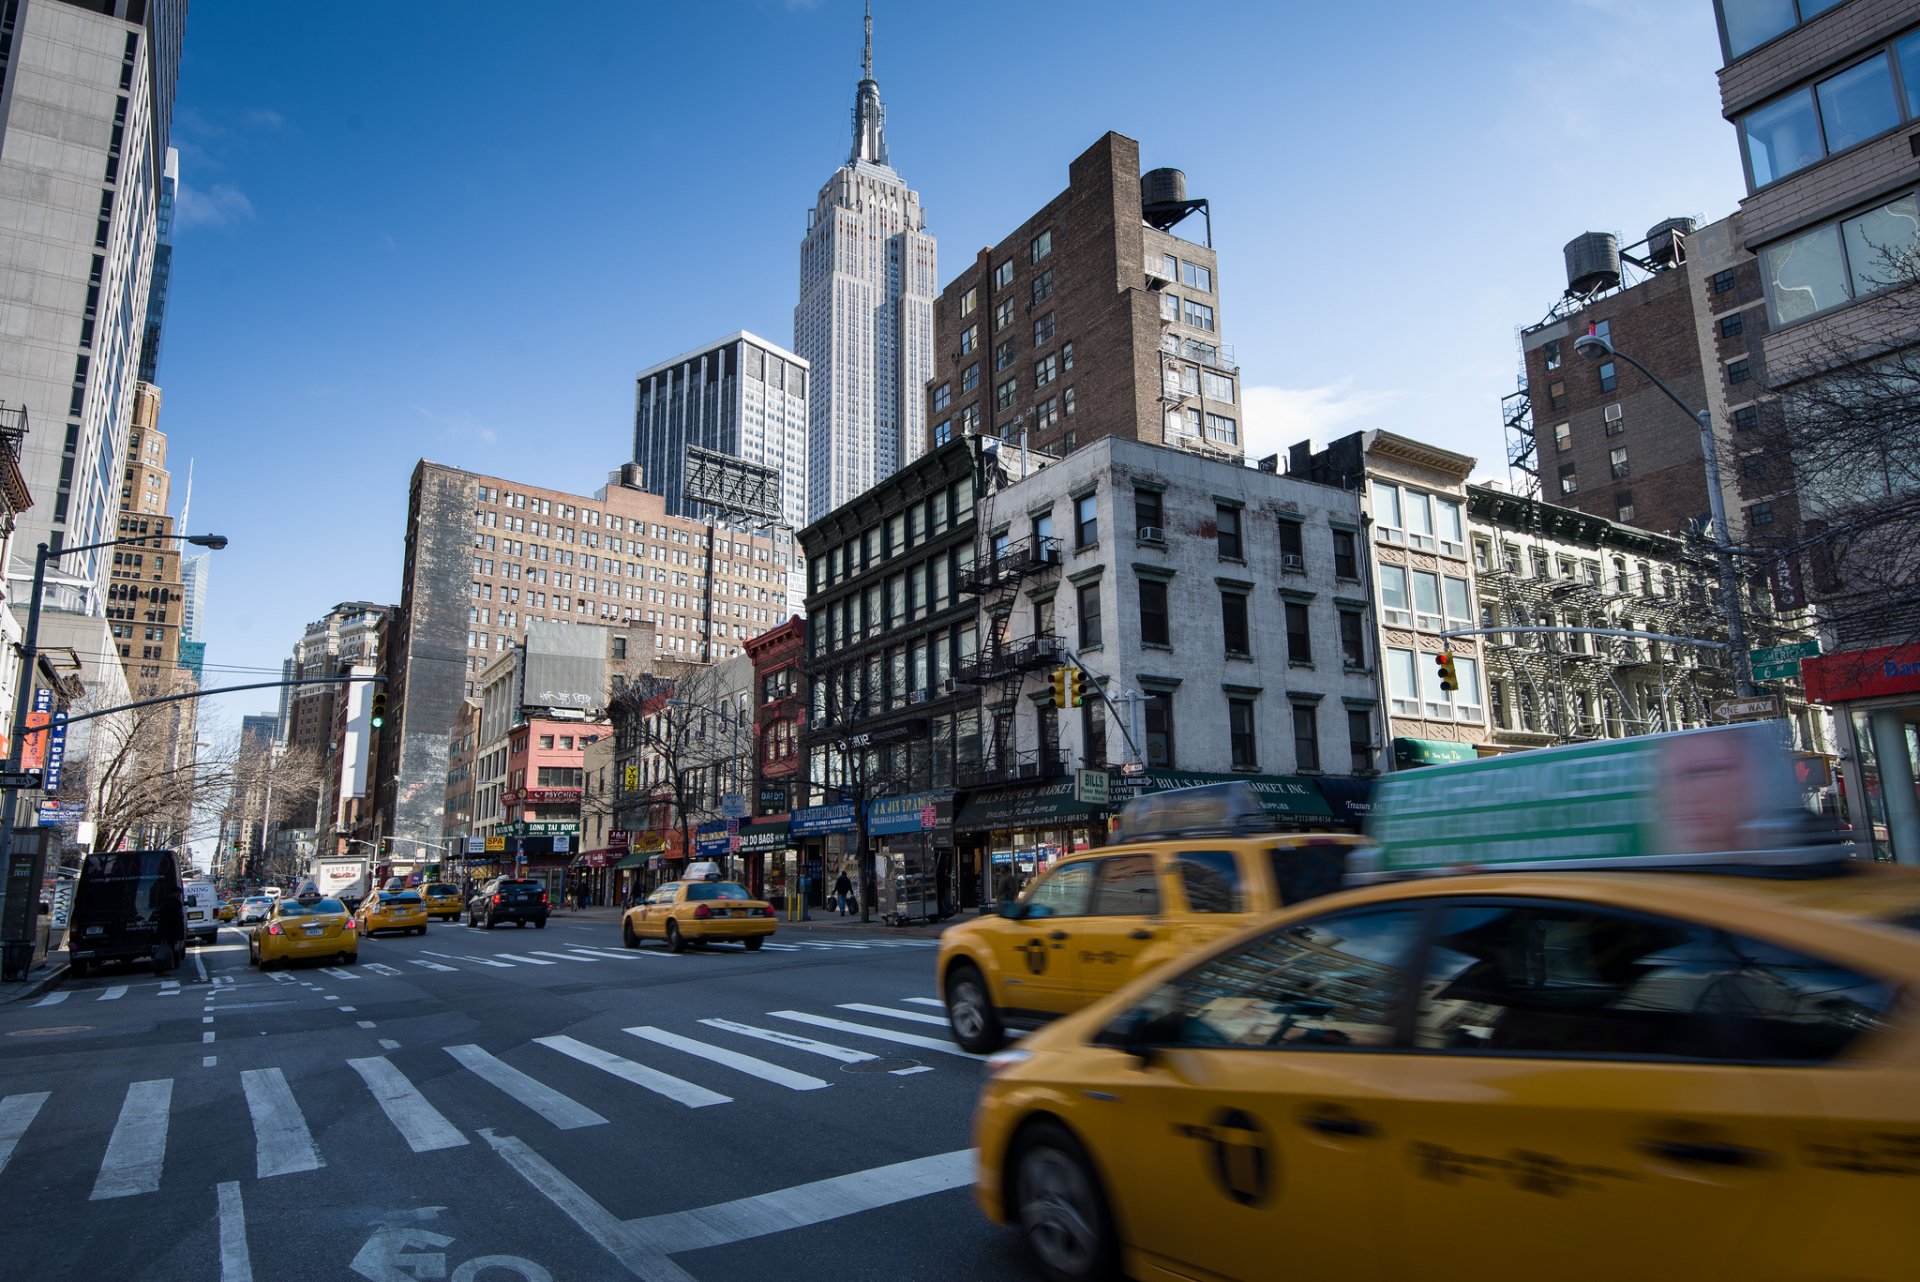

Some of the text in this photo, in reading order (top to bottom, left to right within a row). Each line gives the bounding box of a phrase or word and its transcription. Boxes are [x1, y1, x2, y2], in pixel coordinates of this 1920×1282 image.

[1762, 648, 1806, 662] AMERICAS
[1764, 666, 1771, 679] 6
[1720, 702, 1769, 716] ONE WAY
[628, 767, 636, 791] YOGA
[1085, 773, 1104, 788] BILL'S
[1156, 777, 1194, 790] BILL'S
[544, 791, 578, 799] PSYCHIC
[1110, 787, 1134, 795] LOWE
[529, 823, 546, 831] LONG
[547, 823, 559, 831] TAI
[560, 823, 578, 831] BODY
[487, 837, 504, 845] SPA
[749, 834, 757, 845] DO
[758, 832, 775, 844] BAGS
